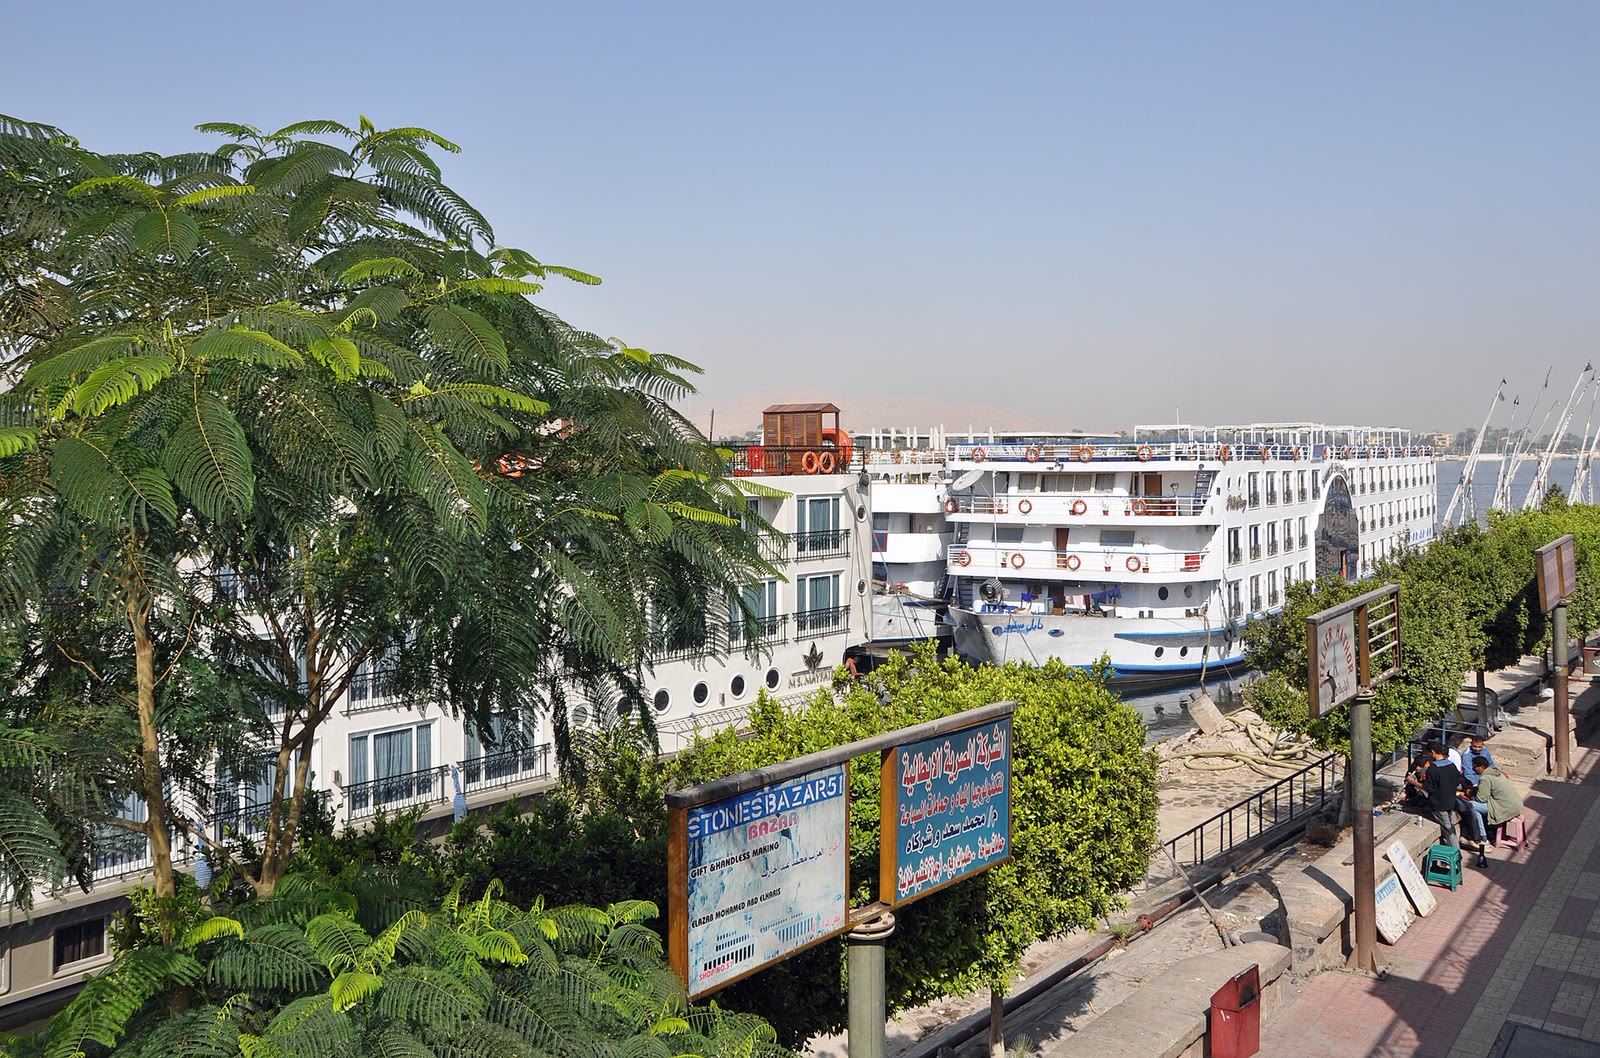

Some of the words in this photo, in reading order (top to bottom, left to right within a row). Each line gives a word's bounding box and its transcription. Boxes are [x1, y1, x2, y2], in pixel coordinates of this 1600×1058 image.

[1336, 623, 1354, 674] HATHOR
[805, 671, 833, 686] MAYFAI
[944, 737, 976, 784] المصرية
[976, 723, 1006, 770] الشركة
[747, 812, 799, 840] BAZAR
[942, 821, 961, 842] سعد
[962, 810, 987, 832] محمد
[690, 865, 708, 879] GIFT
[752, 841, 780, 859] MAKING
[691, 913, 715, 929] ELAZAB
[714, 902, 746, 923] MOHAMED
[746, 897, 759, 910] ABD
